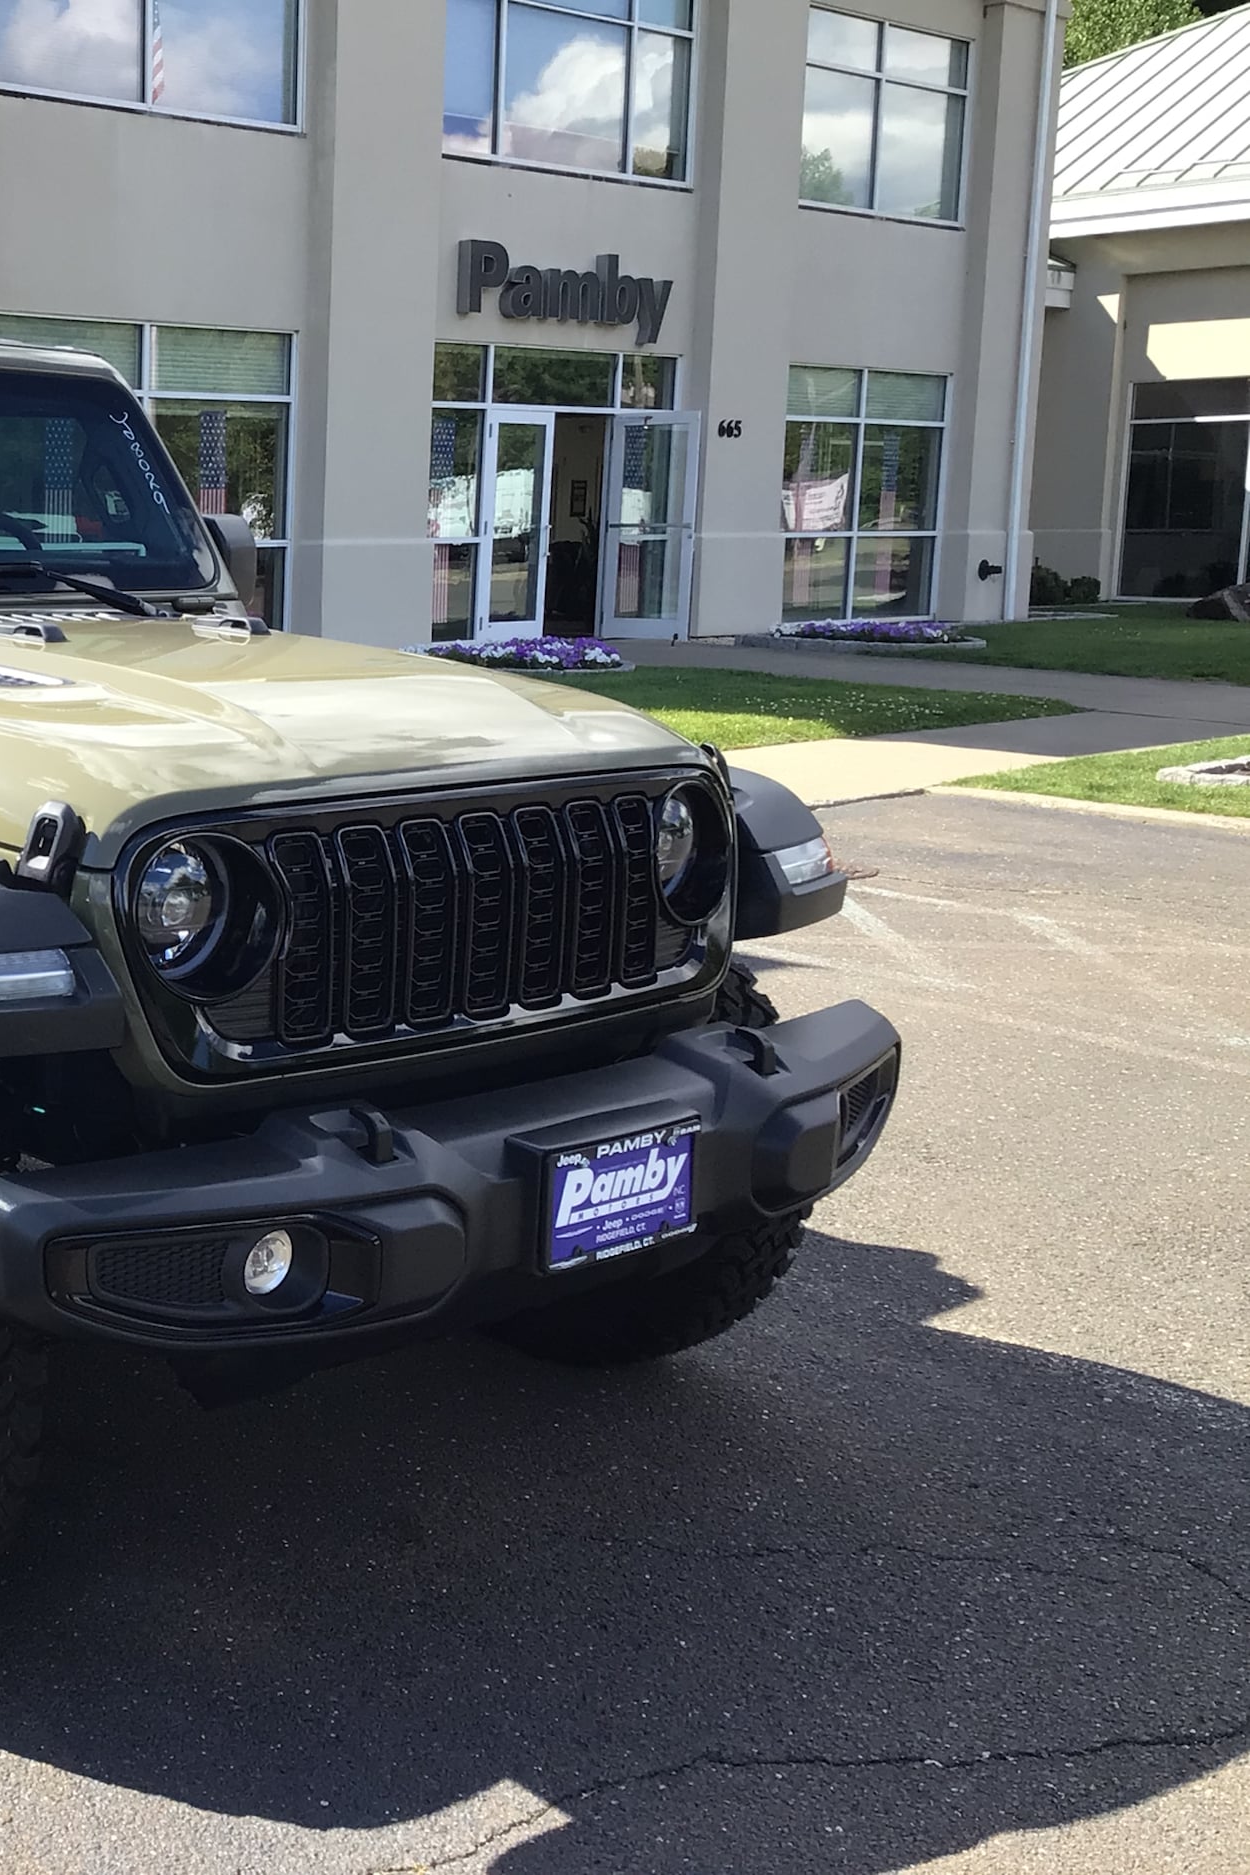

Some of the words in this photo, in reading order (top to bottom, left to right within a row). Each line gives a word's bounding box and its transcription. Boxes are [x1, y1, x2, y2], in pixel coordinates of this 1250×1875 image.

[456, 239, 674, 346] Pamby
[717, 419, 742, 438] 665
[556, 1153, 582, 1168] Jeep
[596, 1130, 667, 1158] PAMBY
[555, 1147, 688, 1229] Pamby
[602, 1218, 623, 1231] Jeep
